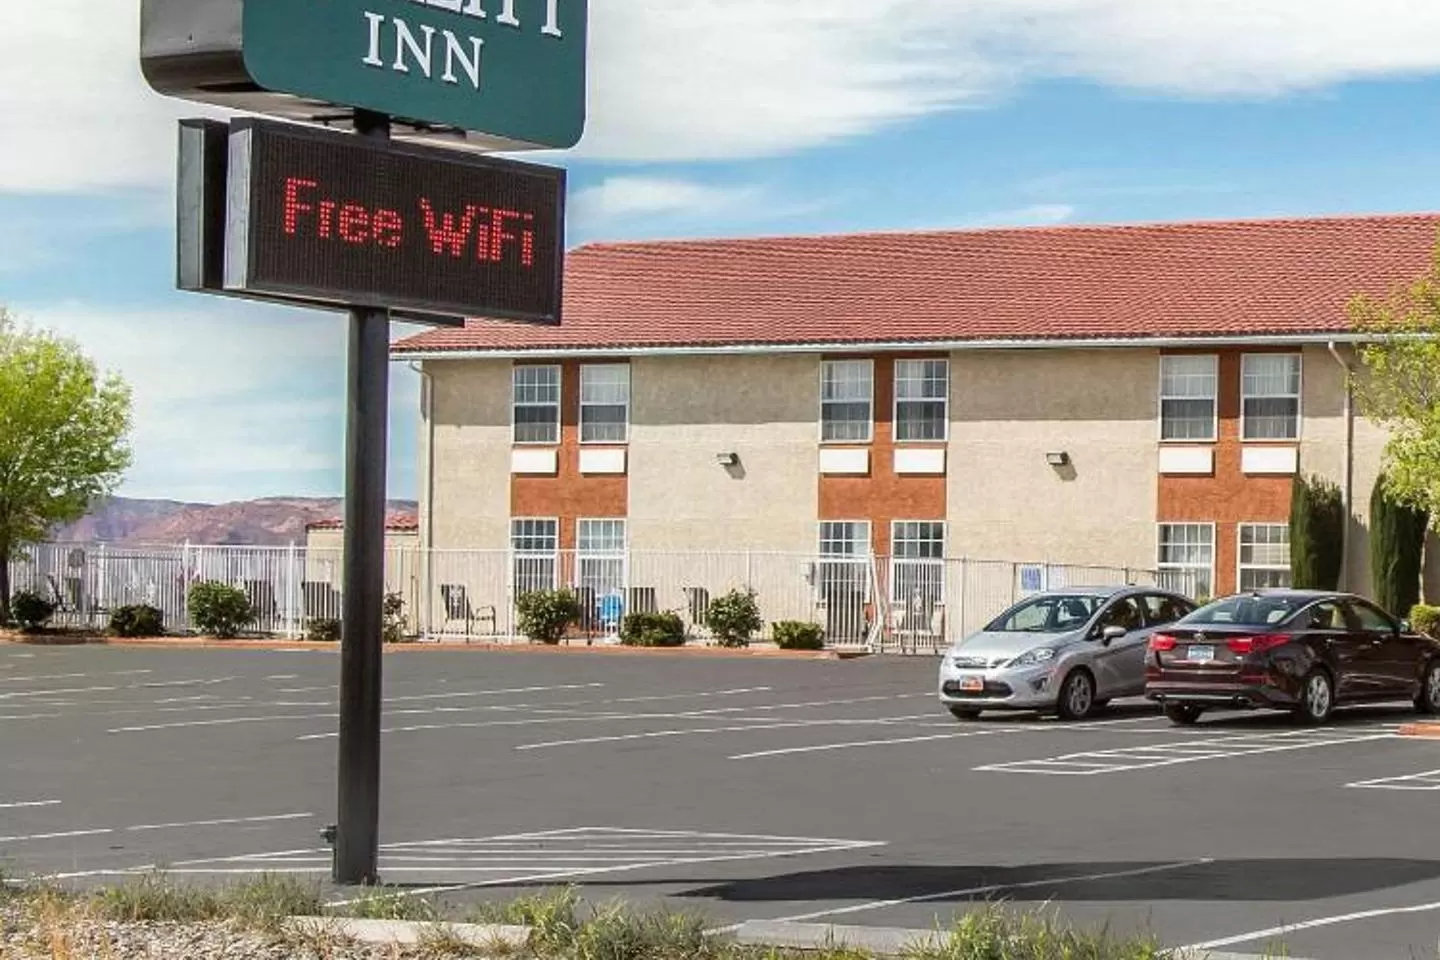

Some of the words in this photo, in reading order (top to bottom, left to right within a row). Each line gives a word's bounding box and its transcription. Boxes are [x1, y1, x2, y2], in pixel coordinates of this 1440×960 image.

[362, 11, 484, 88] INN
[283, 175, 401, 248] Free
[418, 196, 536, 267] WiFi
